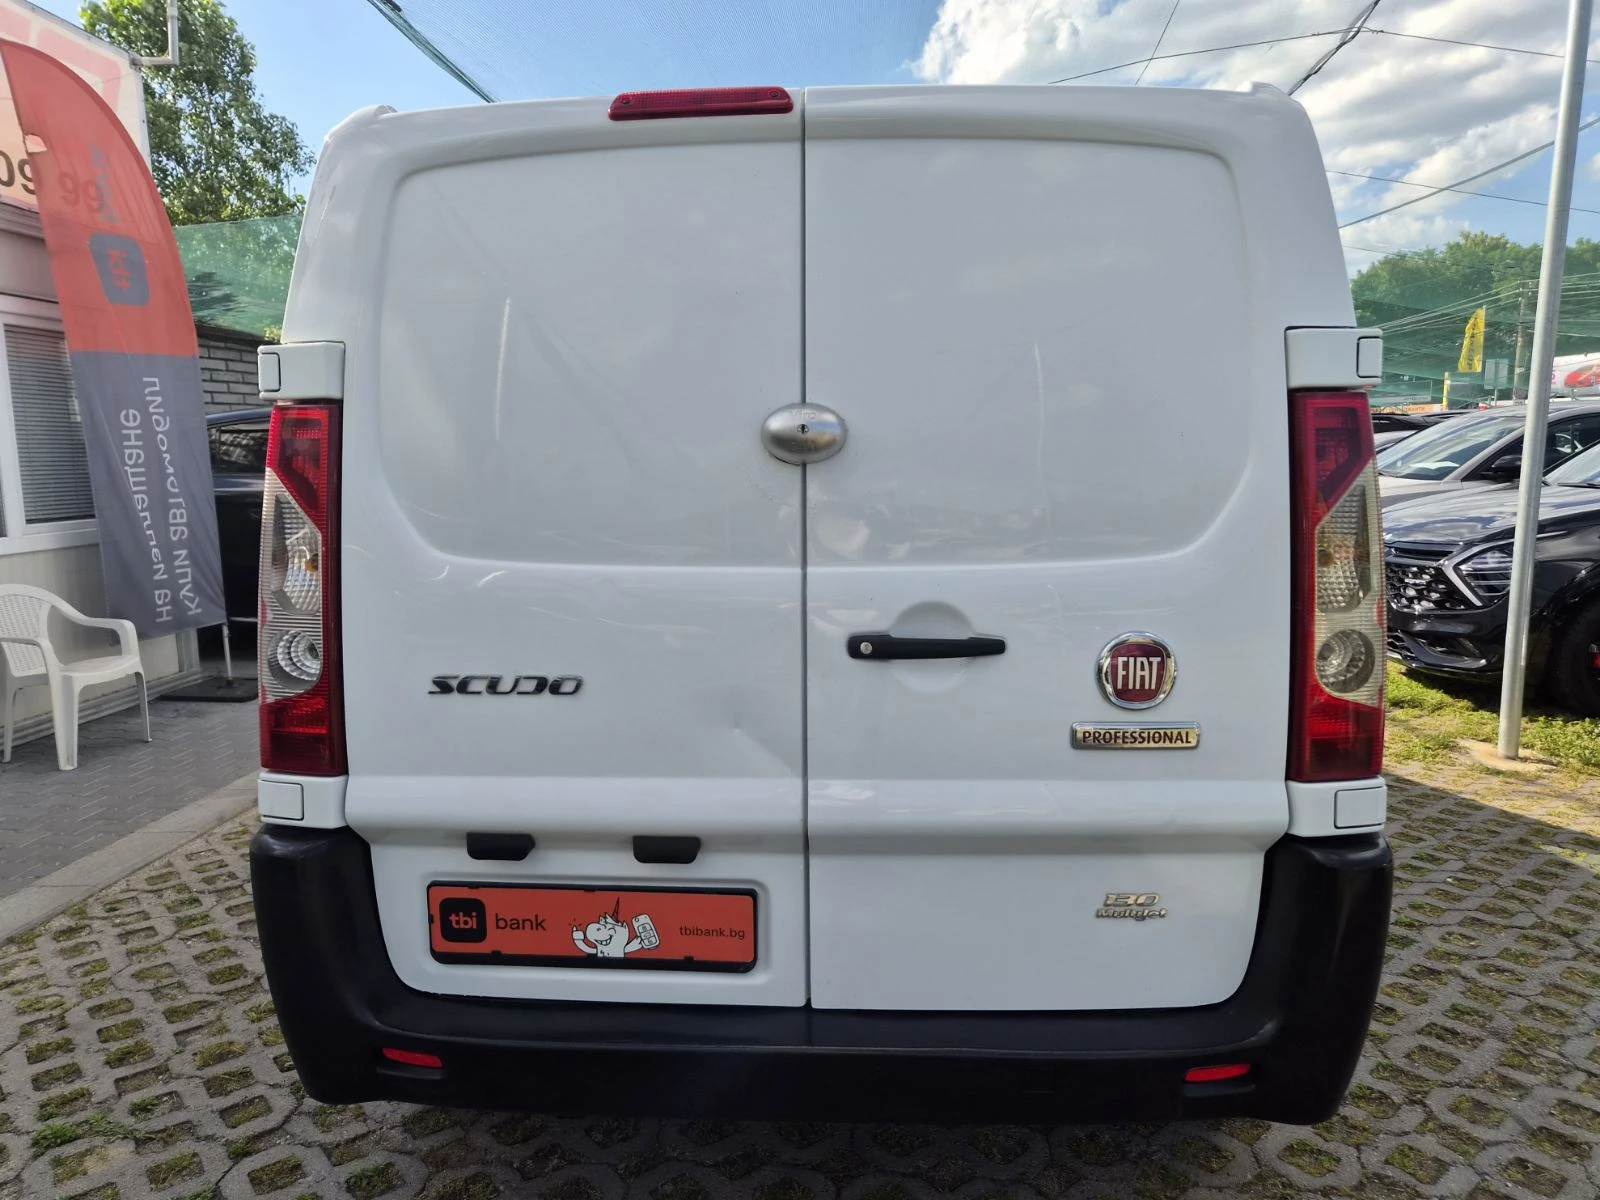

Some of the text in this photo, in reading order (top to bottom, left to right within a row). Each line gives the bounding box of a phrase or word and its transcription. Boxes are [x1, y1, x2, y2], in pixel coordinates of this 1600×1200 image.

[1117, 656, 1162, 690] FIAT
[428, 674, 584, 696] SCUDO
[1082, 731, 1192, 745] PROFESSIONAL
[449, 912, 547, 932] tbi bank
[679, 925, 746, 941] tbibank.bg
